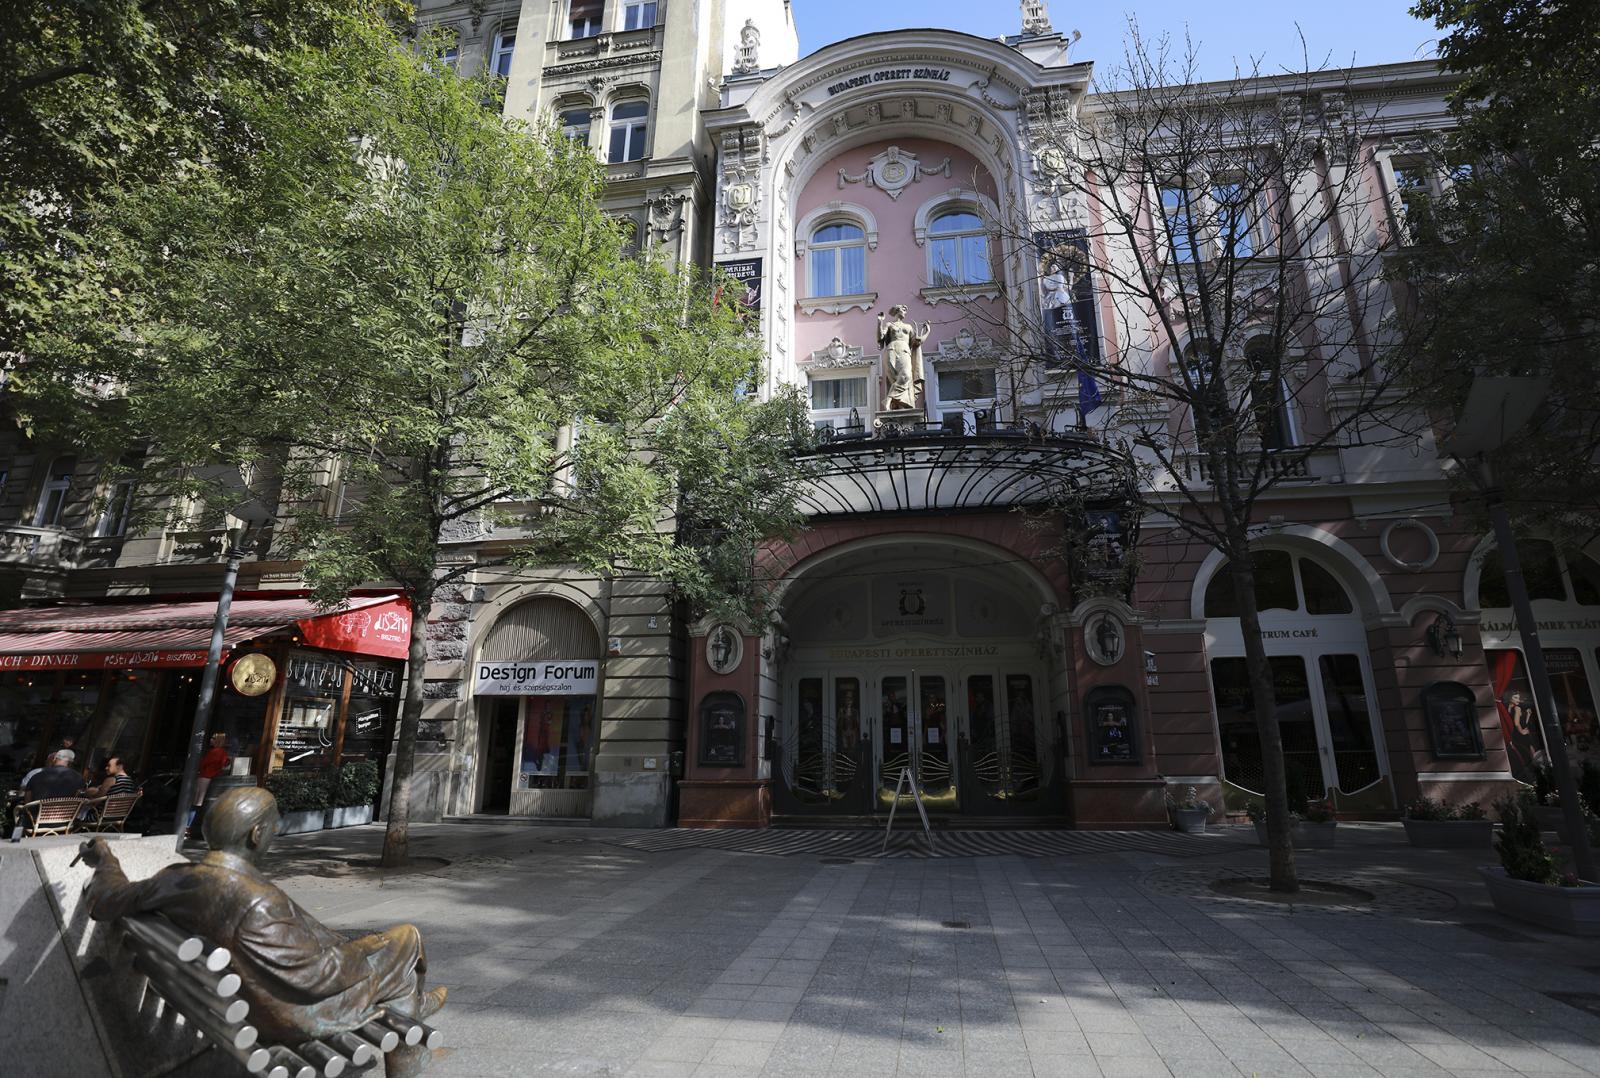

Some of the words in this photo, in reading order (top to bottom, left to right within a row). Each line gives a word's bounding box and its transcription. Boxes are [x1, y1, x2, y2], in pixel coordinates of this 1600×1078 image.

[828, 75, 872, 96] BUDAPESTI
[873, 69, 912, 82] OPERETT
[913, 67, 951, 81] SZÍNHÁZ
[1537, 621, 1566, 630] MRE
[1292, 627, 1318, 638] CAFÉ
[31, 654, 79, 666] DINNER
[480, 663, 536, 683] Design
[544, 665, 595, 680] Forum
[499, 683, 511, 693] haj
